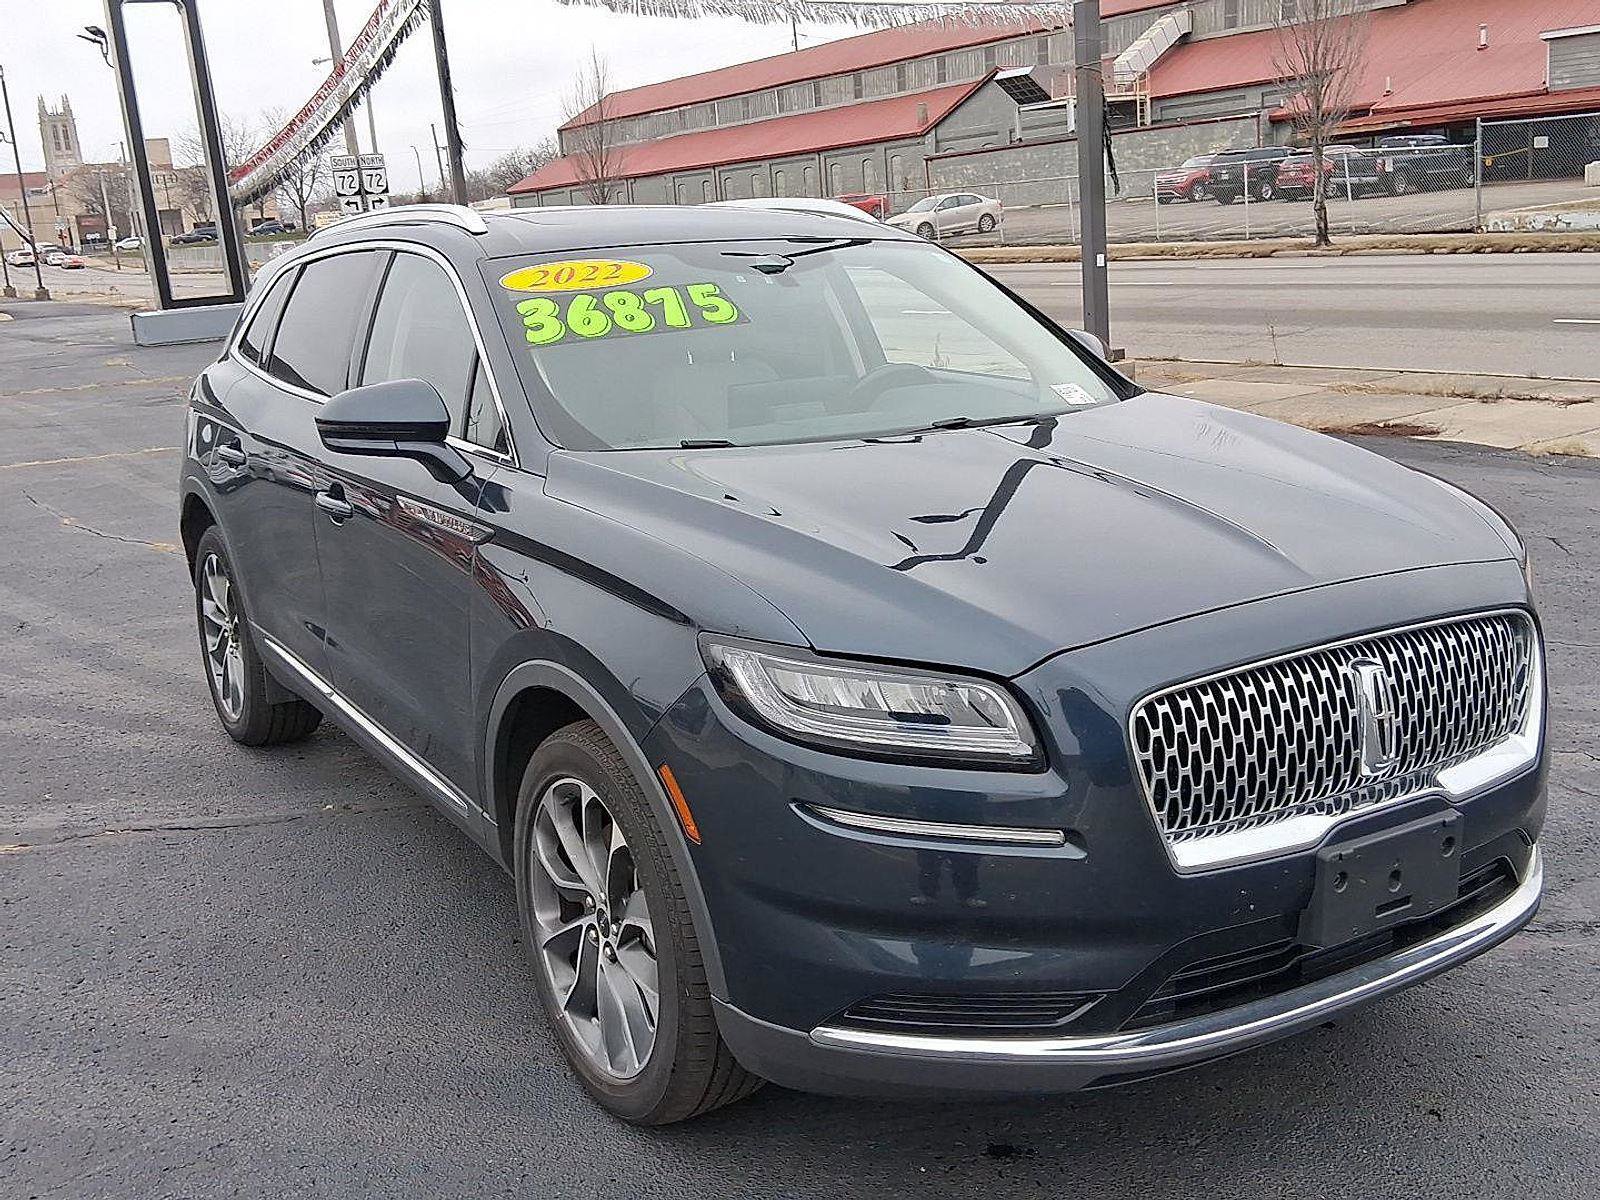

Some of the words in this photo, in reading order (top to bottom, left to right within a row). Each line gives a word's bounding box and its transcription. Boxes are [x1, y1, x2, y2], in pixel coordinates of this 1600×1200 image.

[332, 157, 356, 167] SOUTH
[360, 156, 384, 166] NORTH
[339, 175, 356, 189] 72
[366, 174, 384, 188] 72
[528, 263, 625, 288] 2022
[516, 282, 739, 347] 36875
